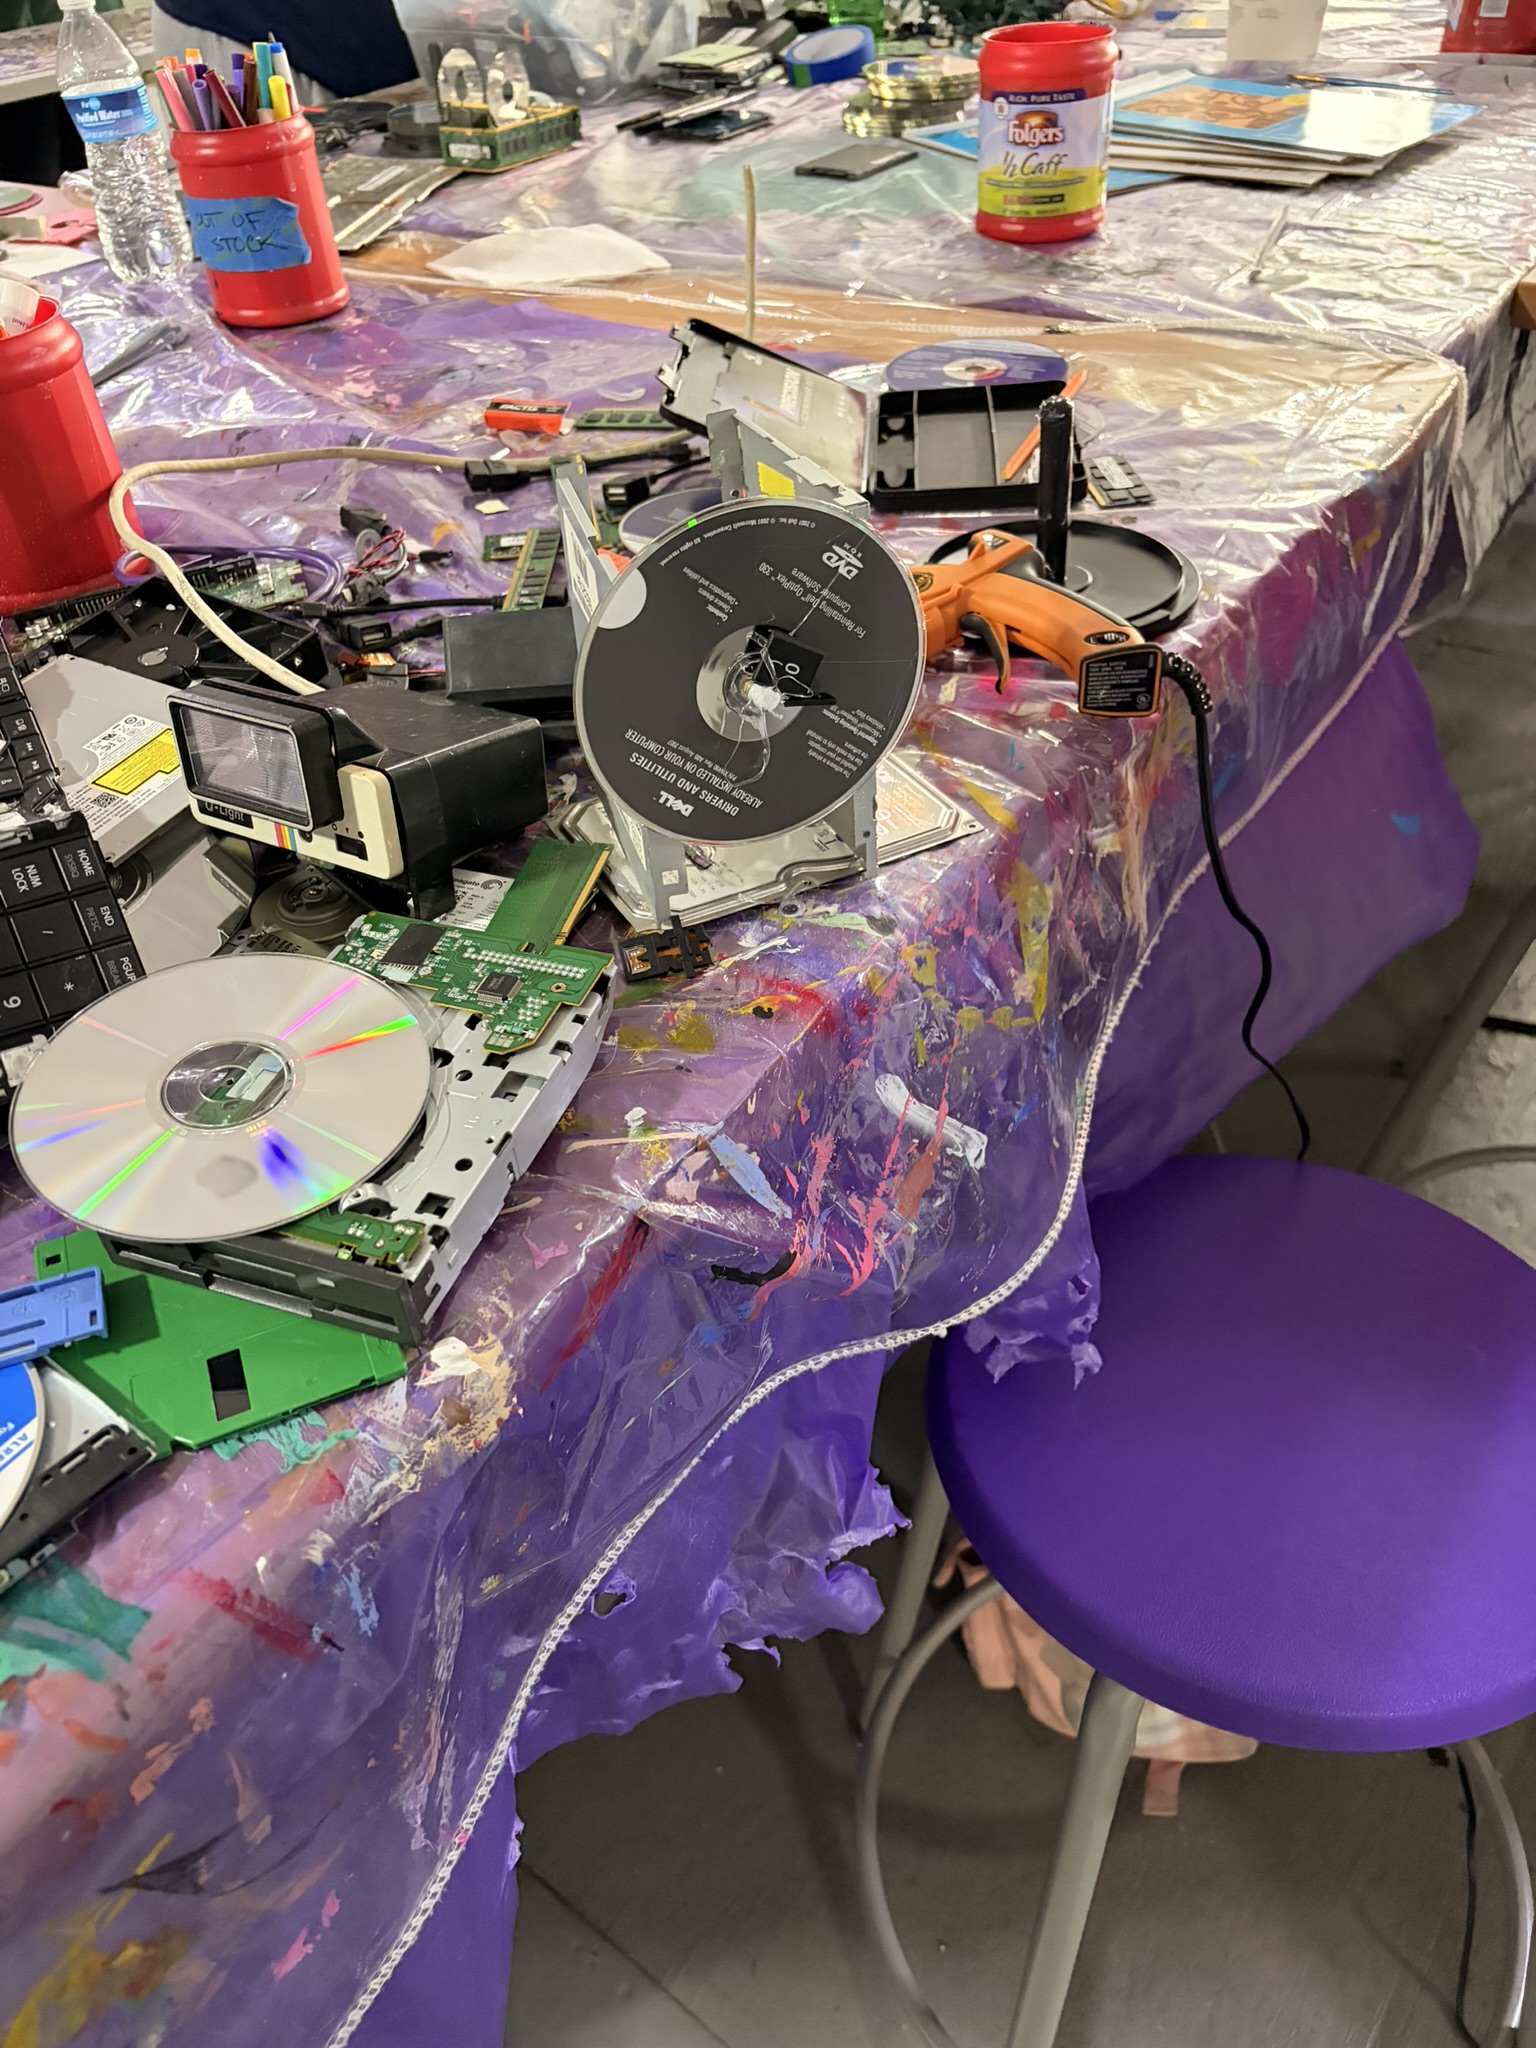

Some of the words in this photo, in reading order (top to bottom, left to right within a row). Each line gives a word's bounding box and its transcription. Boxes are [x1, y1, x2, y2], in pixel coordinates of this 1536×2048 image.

[1030, 94, 1051, 103] PURE
[1008, 120, 1064, 148] Folgers
[1021, 152, 1068, 176] Caff
[231, 210, 265, 231] OF
[211, 229, 289, 253] STOCK
[499, 404, 539, 412] FACTIS
[733, 518, 757, 529] Microsoft
[758, 562, 773, 576] 330
[822, 552, 859, 580] DVD
[791, 568, 821, 593] Software
[820, 588, 851, 613] Computer
[819, 601, 855, 631] Reinstalling
[854, 626, 867, 638] For
[625, 728, 666, 758] COMPUTER
[629, 752, 676, 784] UTILITIES
[664, 751, 685, 768] YOUR
[684, 762, 696, 773] ON
[677, 779, 700, 796] AND
[695, 767, 734, 791] INSTALLED
[699, 790, 739, 817] DRIVERS
[734, 786, 763, 809] ALREADY
[64, 853, 80, 878] SYSRQ
[77, 849, 95, 877] HOME
[11, 868, 29, 893] LOCK
[25, 864, 42, 888] NUM
[453, 878, 480, 887] eagate
[85, 906, 101, 932] PRTSC
[100, 905, 115, 926] END
[106, 960, 123, 986] BREAK
[120, 956, 137, 982] PGUP
